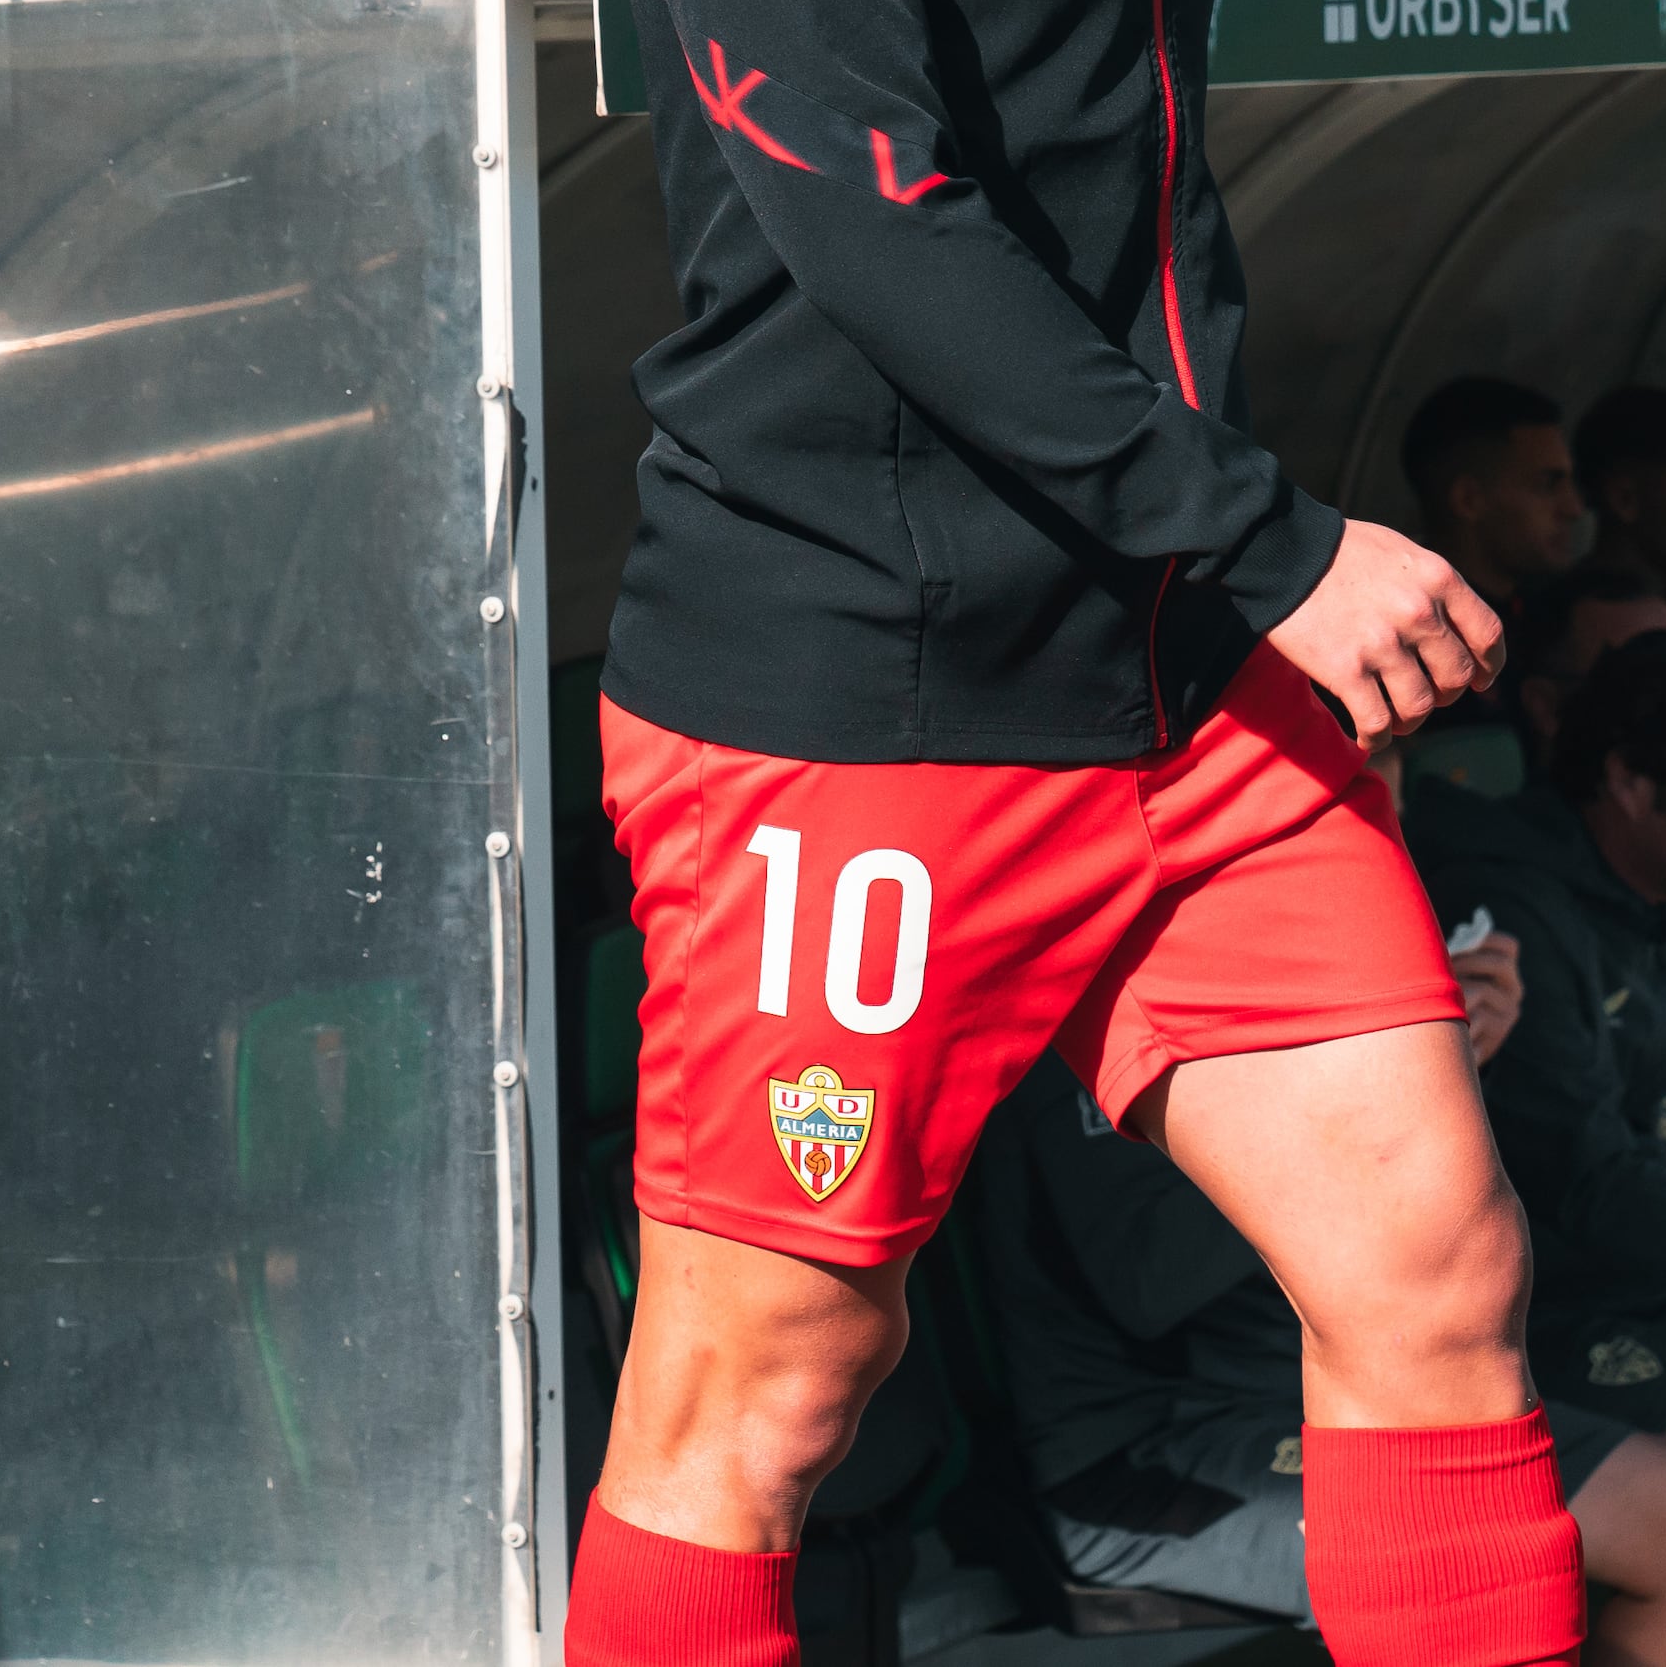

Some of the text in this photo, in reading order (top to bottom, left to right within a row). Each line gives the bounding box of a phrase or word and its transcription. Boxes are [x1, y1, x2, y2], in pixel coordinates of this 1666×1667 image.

[744, 823, 933, 1036] 10
[781, 1091, 859, 1114] U D
[779, 1118, 859, 1140] ALMERIA
